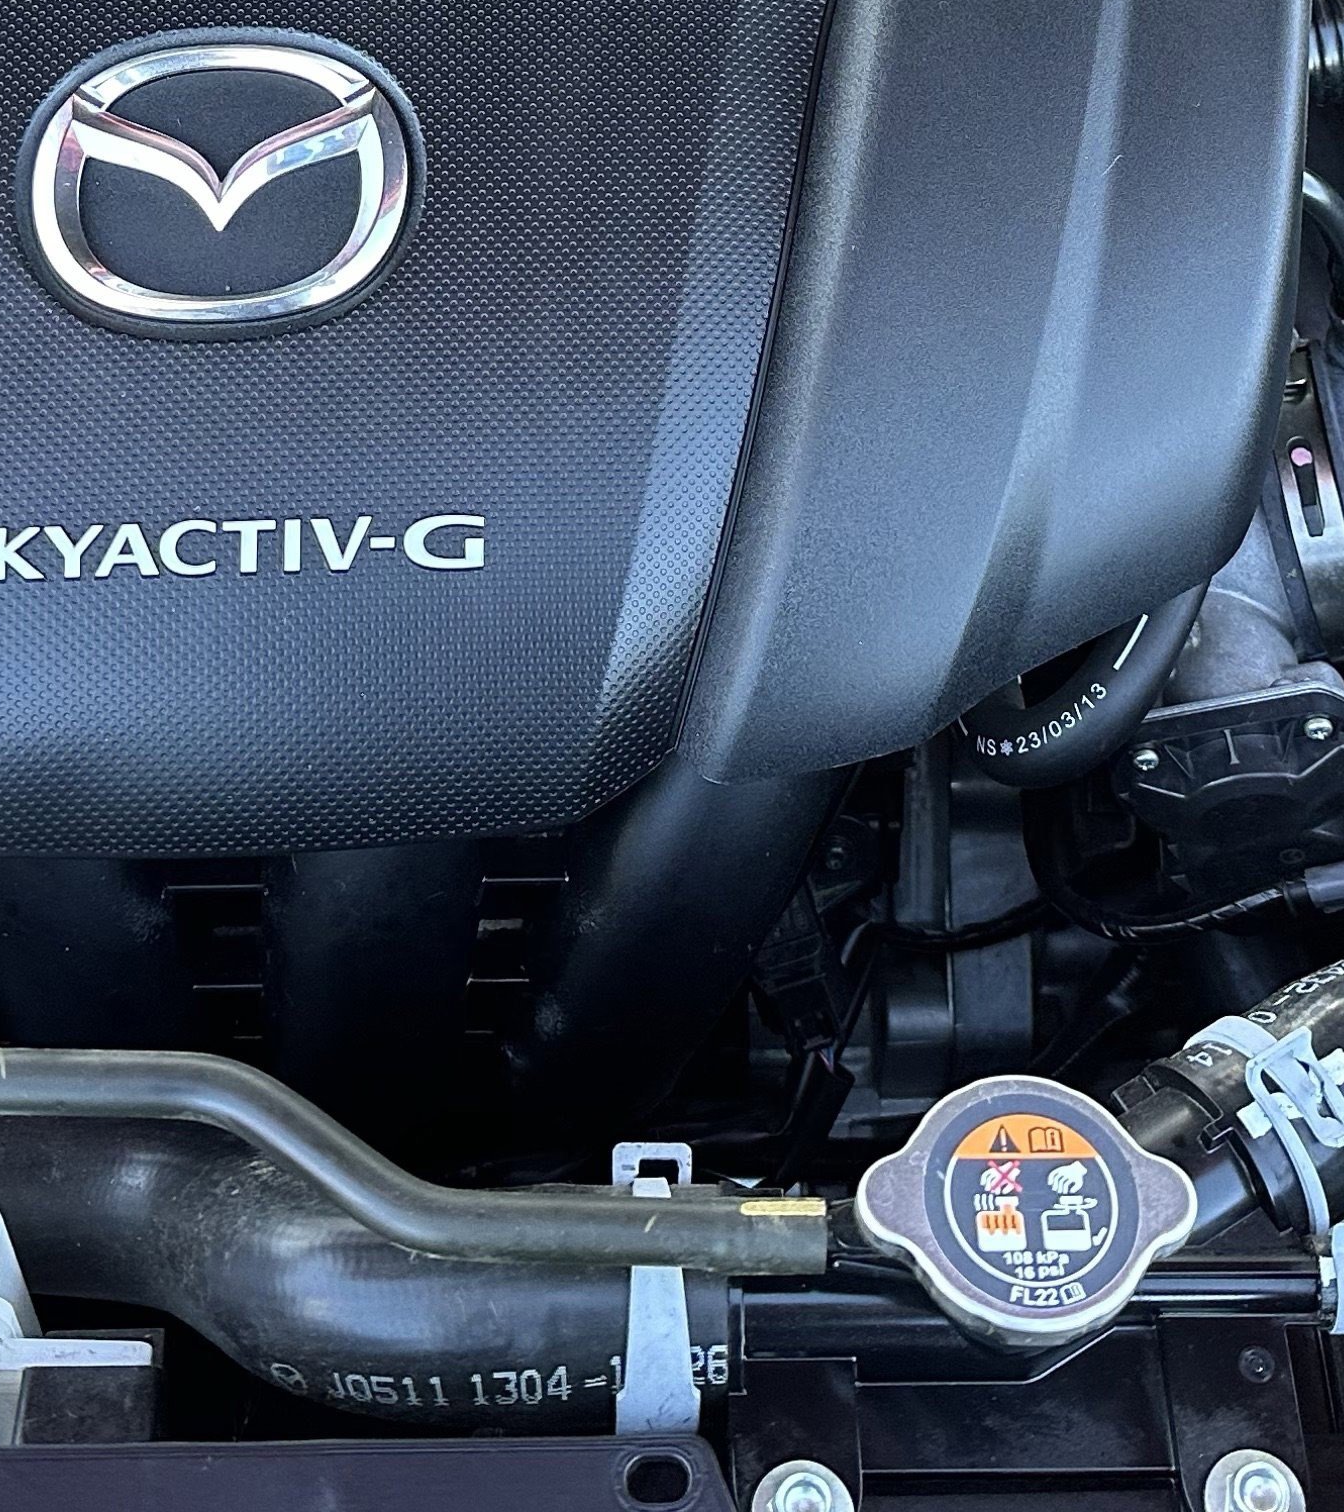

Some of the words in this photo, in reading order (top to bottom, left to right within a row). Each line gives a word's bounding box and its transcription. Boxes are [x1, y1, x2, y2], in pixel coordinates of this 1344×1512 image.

[1186, 1043, 1233, 1067] 14
[1002, 1251, 1034, 1265] 108
[1036, 1251, 1070, 1265] kPa
[1014, 1266, 1036, 1280] 16
[1037, 1264, 1065, 1280] psi
[1009, 1285, 1060, 1307] FL22
[328, 1372, 451, 1406] J0511
